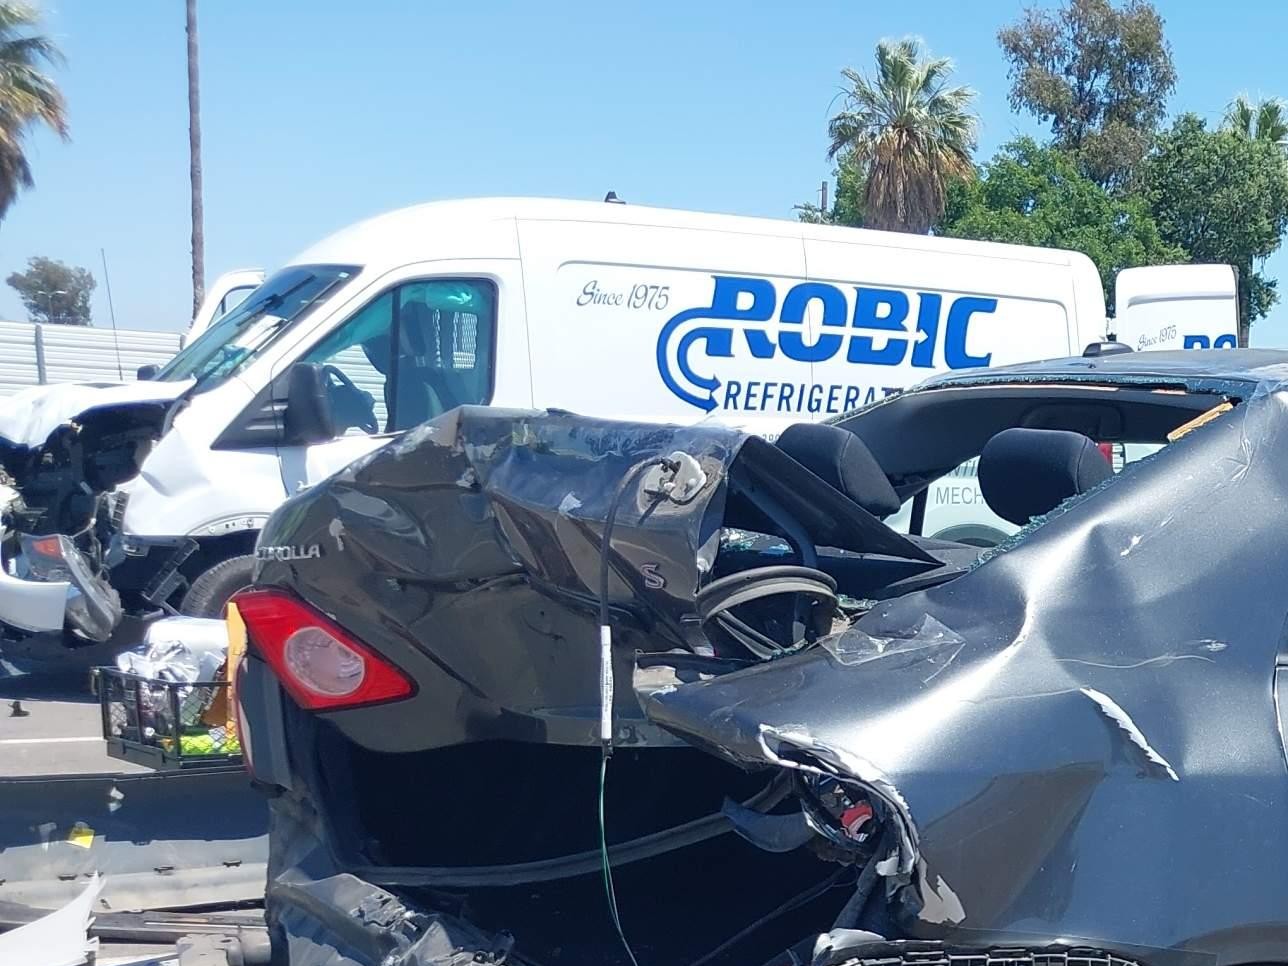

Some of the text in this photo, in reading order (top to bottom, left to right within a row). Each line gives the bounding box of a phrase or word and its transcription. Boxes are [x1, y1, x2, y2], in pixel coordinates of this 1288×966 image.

[576, 280, 670, 310] Since 1975
[706, 275, 998, 370] ROBIC
[1159, 325, 1177, 343] 1975
[640, 563, 665, 589] S
